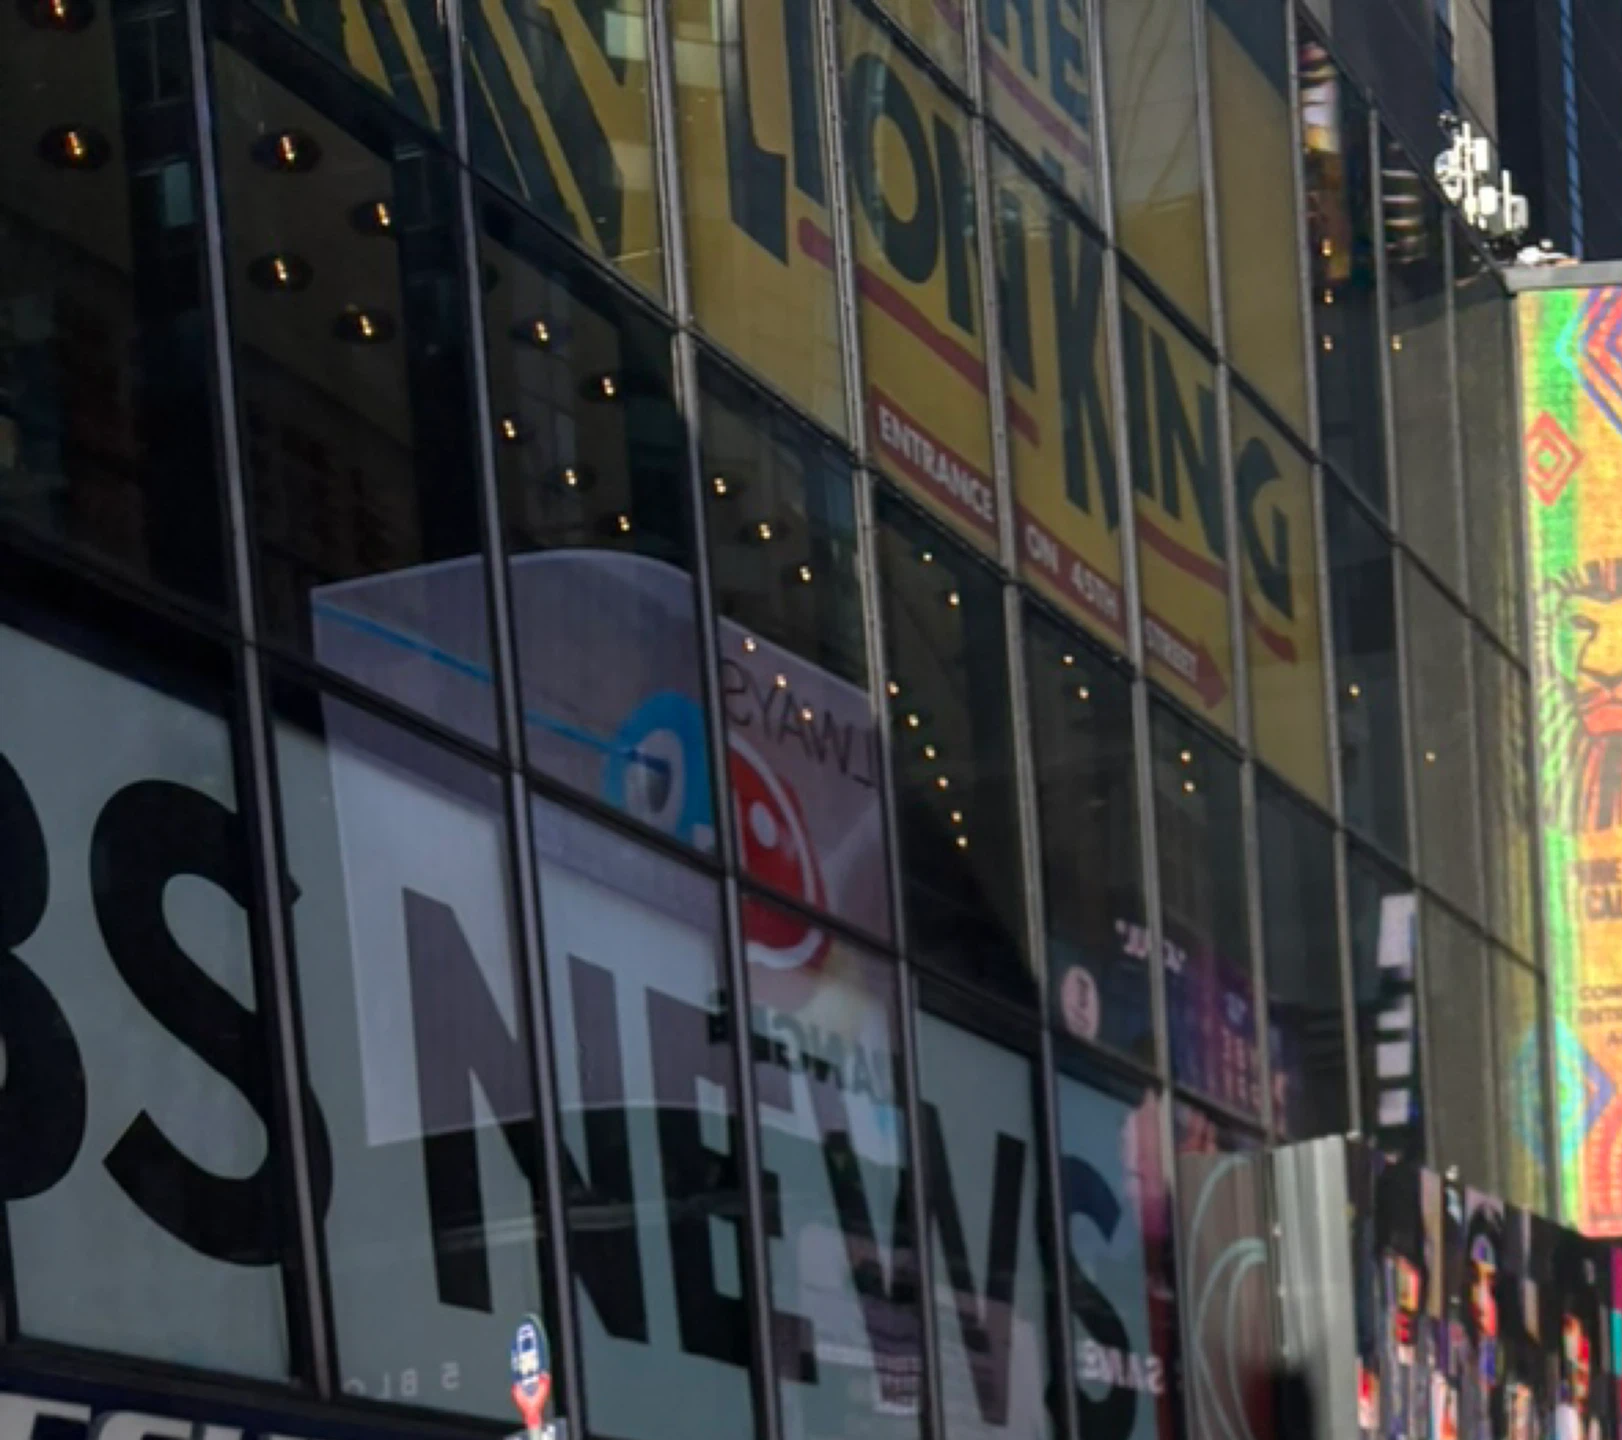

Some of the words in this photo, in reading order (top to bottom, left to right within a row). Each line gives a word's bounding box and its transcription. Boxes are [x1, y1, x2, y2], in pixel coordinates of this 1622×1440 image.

[721, 0, 1036, 392] LION
[1046, 145, 1295, 620] KING
[877, 403, 996, 523] ENTRANCE
[1023, 523, 1061, 574] ON
